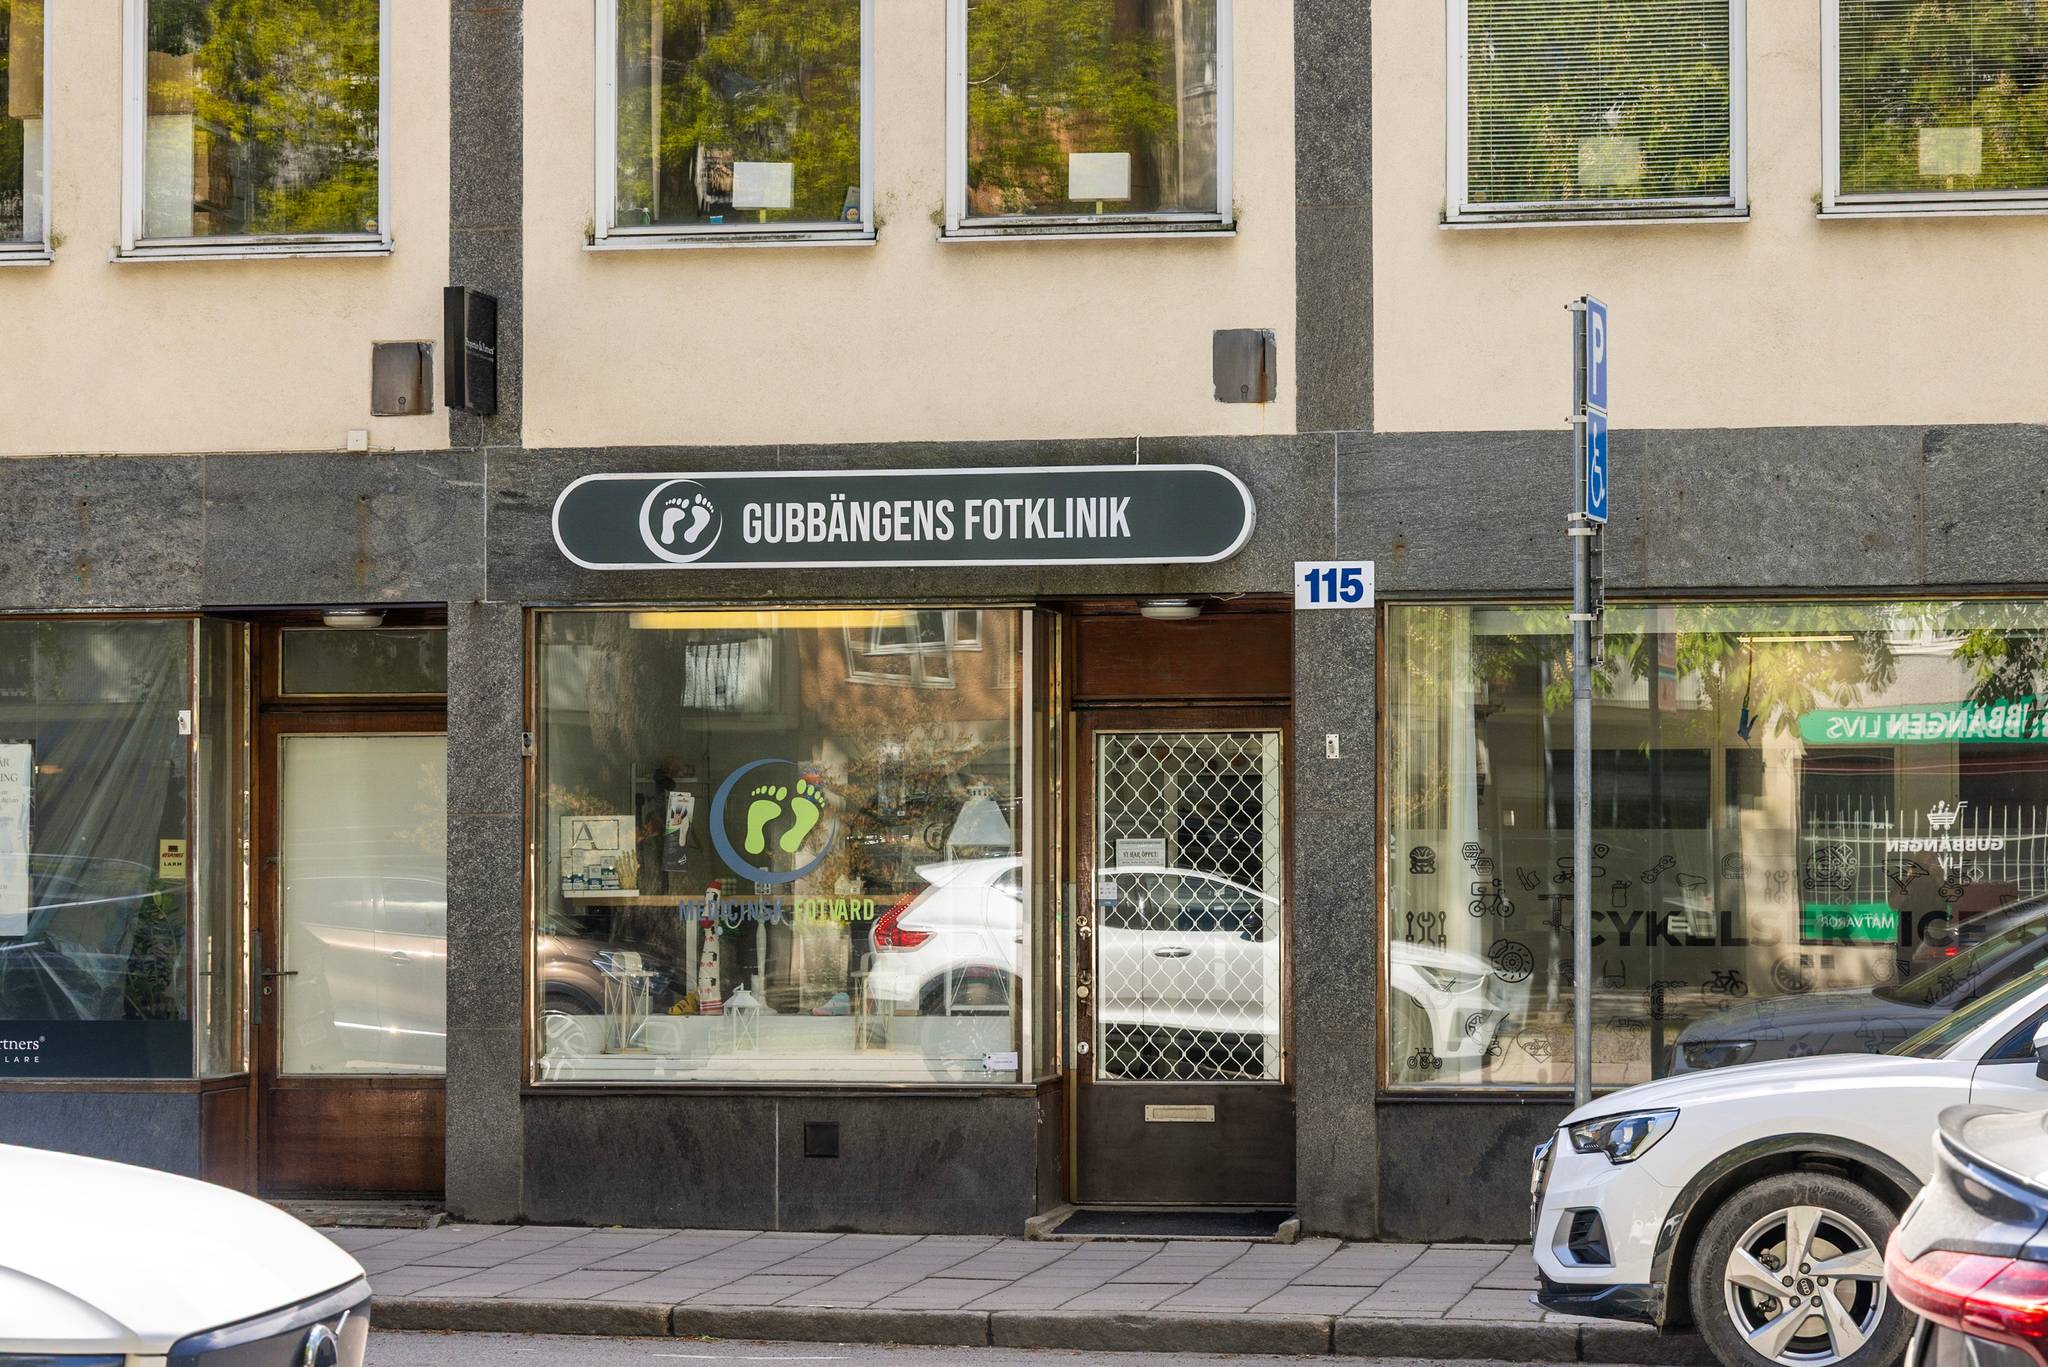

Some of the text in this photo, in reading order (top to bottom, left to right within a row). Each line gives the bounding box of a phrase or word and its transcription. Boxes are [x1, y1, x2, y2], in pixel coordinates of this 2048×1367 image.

[1592, 310, 1604, 395] P
[742, 493, 1131, 544] GUBBÄNGENS FOTKLINIK
[1304, 567, 1364, 603] 115
[794, 894, 876, 922] FOTVÅRD
